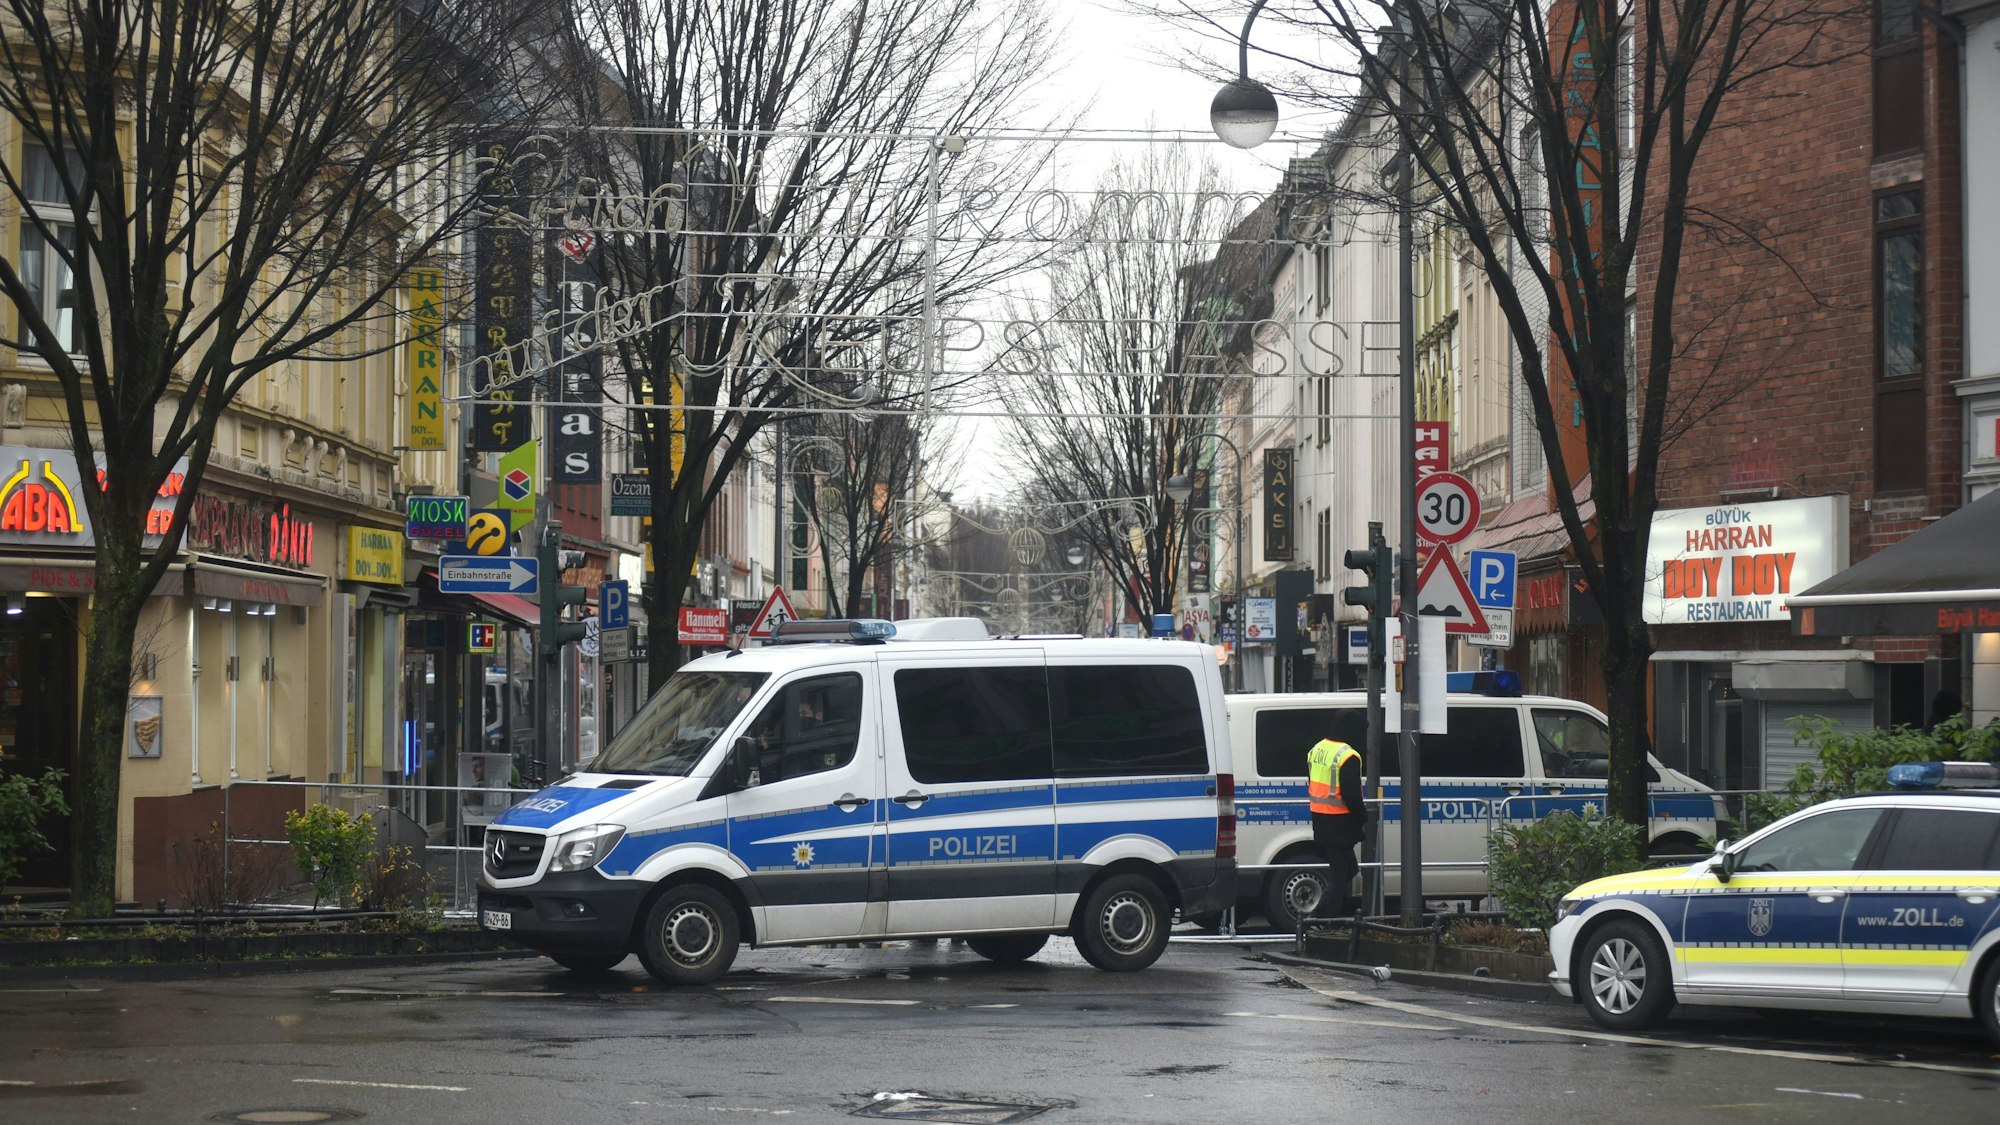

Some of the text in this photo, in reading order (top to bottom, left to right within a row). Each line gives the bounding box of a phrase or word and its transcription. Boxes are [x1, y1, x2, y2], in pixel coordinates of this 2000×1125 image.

[415, 273, 438, 420] HARRAN
[556, 280, 596, 474] Teras
[613, 474, 651, 496] Özcan
[410, 500, 465, 523] KIOSK
[1424, 492, 1465, 526] 30
[1705, 506, 1751, 526] BÜYÜK
[269, 503, 314, 566] DÖNER
[361, 531, 392, 551] HARRAN
[410, 526, 465, 538] GÜZEL
[1686, 524, 1773, 552] HARRAN
[447, 570, 512, 580] Einbahnstraße
[1480, 558, 1505, 600] P
[1663, 551, 1797, 600] DOY DOY
[607, 588, 622, 624] P
[1185, 610, 1209, 622] ASYA
[1687, 600, 1772, 622] RESTAURANT
[1312, 747, 1328, 766] ZOLL
[1427, 801, 1512, 820] POLIZEI
[929, 835, 1017, 857] POLIZEI
[1752, 899, 1769, 907] ZOLL
[1857, 908, 1965, 927] www.ZOLL.de
